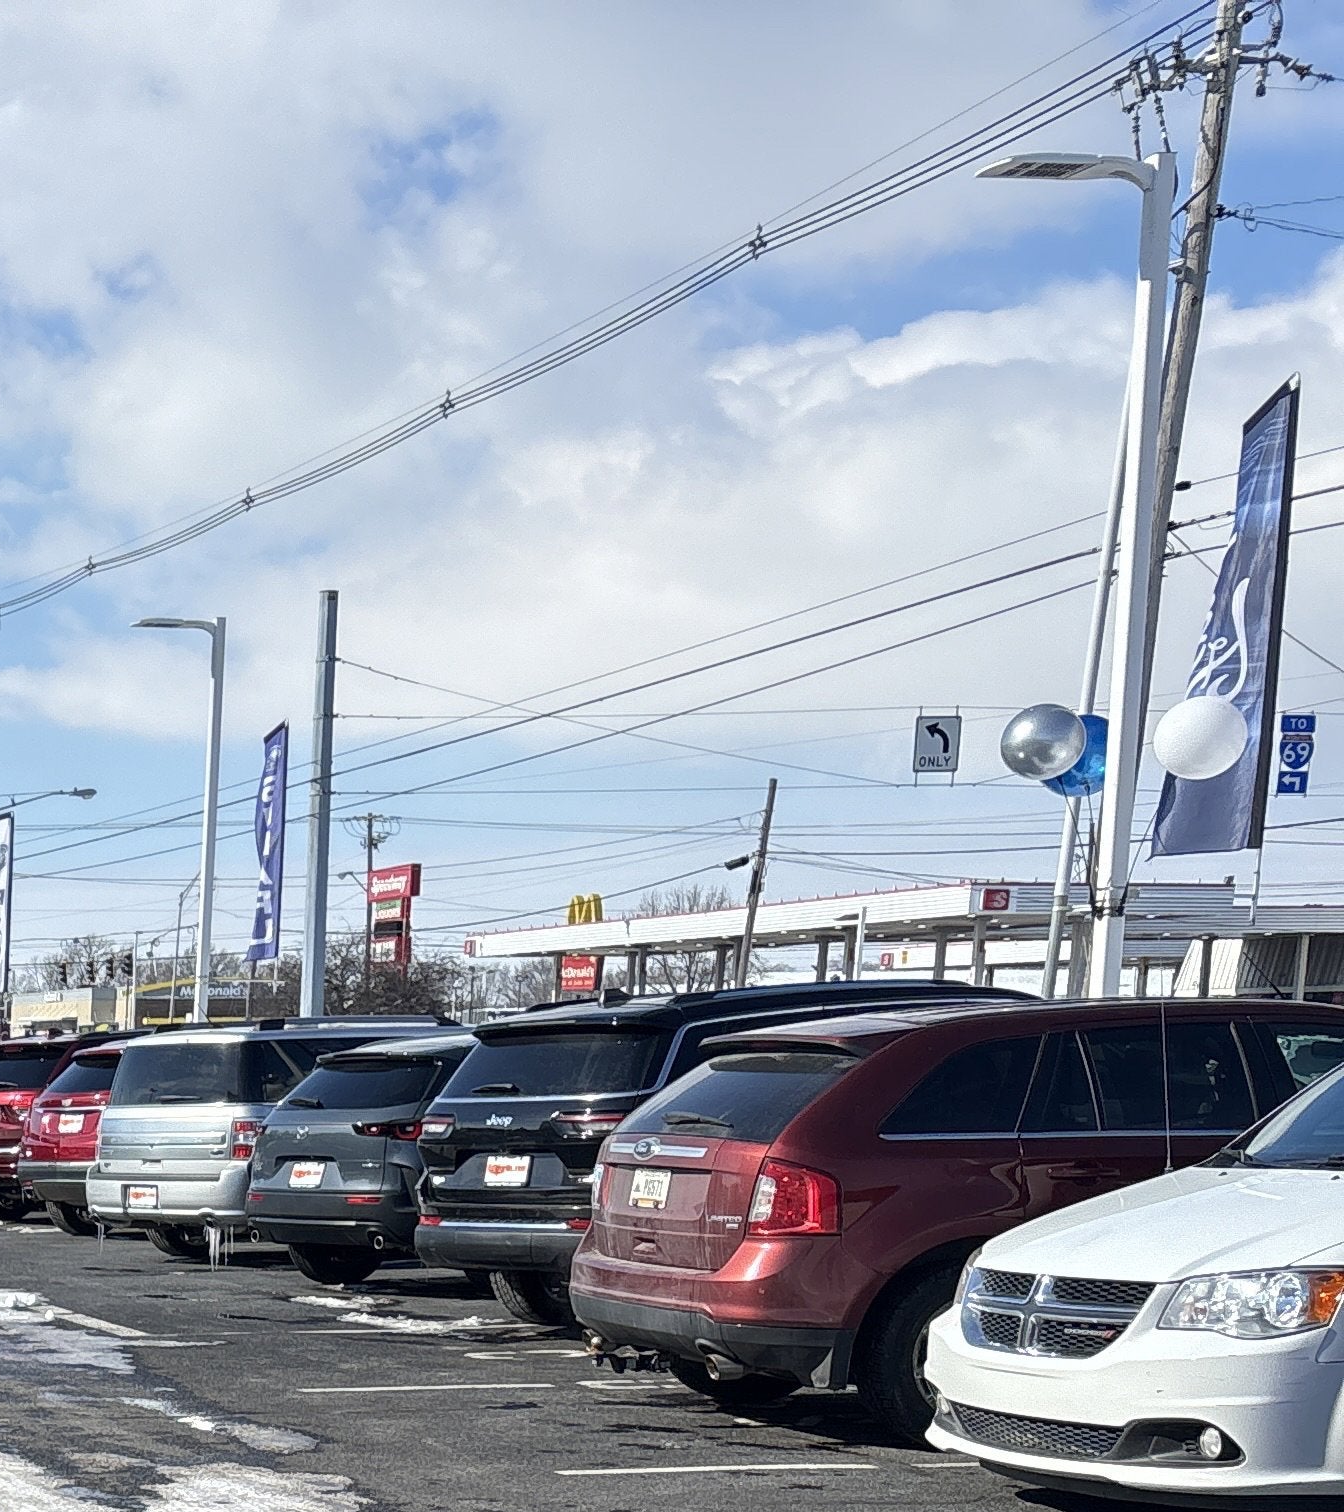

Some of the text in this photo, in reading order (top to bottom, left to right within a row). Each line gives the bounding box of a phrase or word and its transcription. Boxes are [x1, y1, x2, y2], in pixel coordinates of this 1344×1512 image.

[1290, 718, 1307, 729] TO
[1283, 743, 1310, 763] 69
[919, 755, 951, 768] ONLY
[485, 1113, 513, 1127] Jeep
